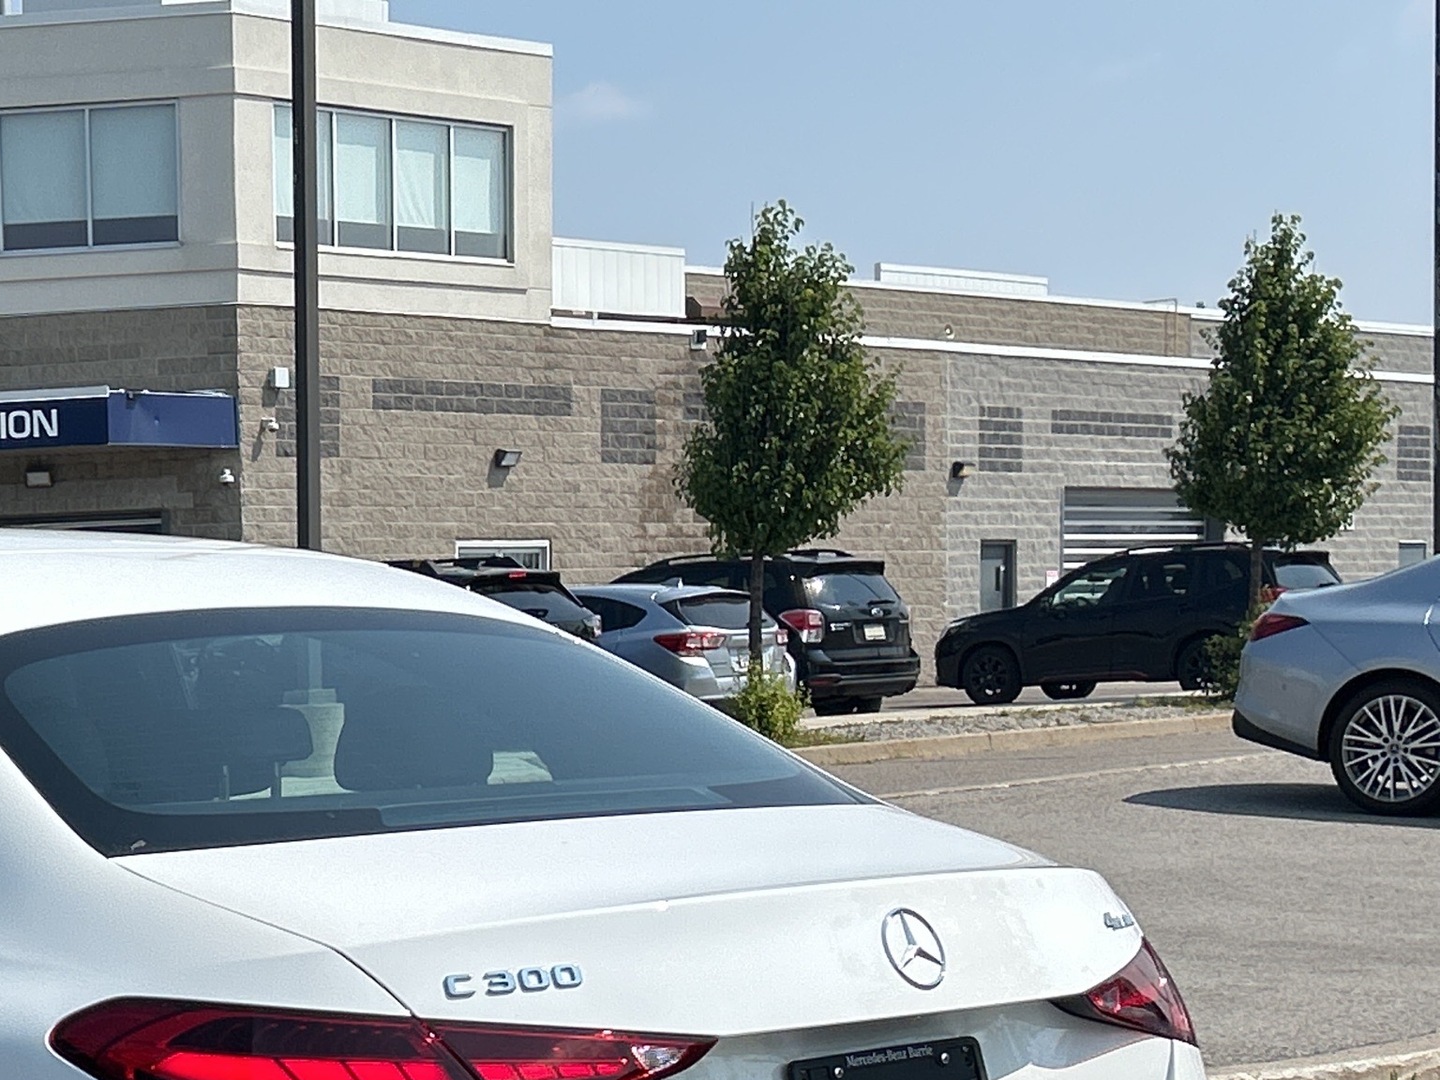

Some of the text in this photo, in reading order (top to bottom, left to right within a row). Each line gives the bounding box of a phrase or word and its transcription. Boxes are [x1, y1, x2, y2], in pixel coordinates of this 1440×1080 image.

[442, 963, 583, 1001] C 300
[845, 1048, 907, 1068] Mercedes-Benz
